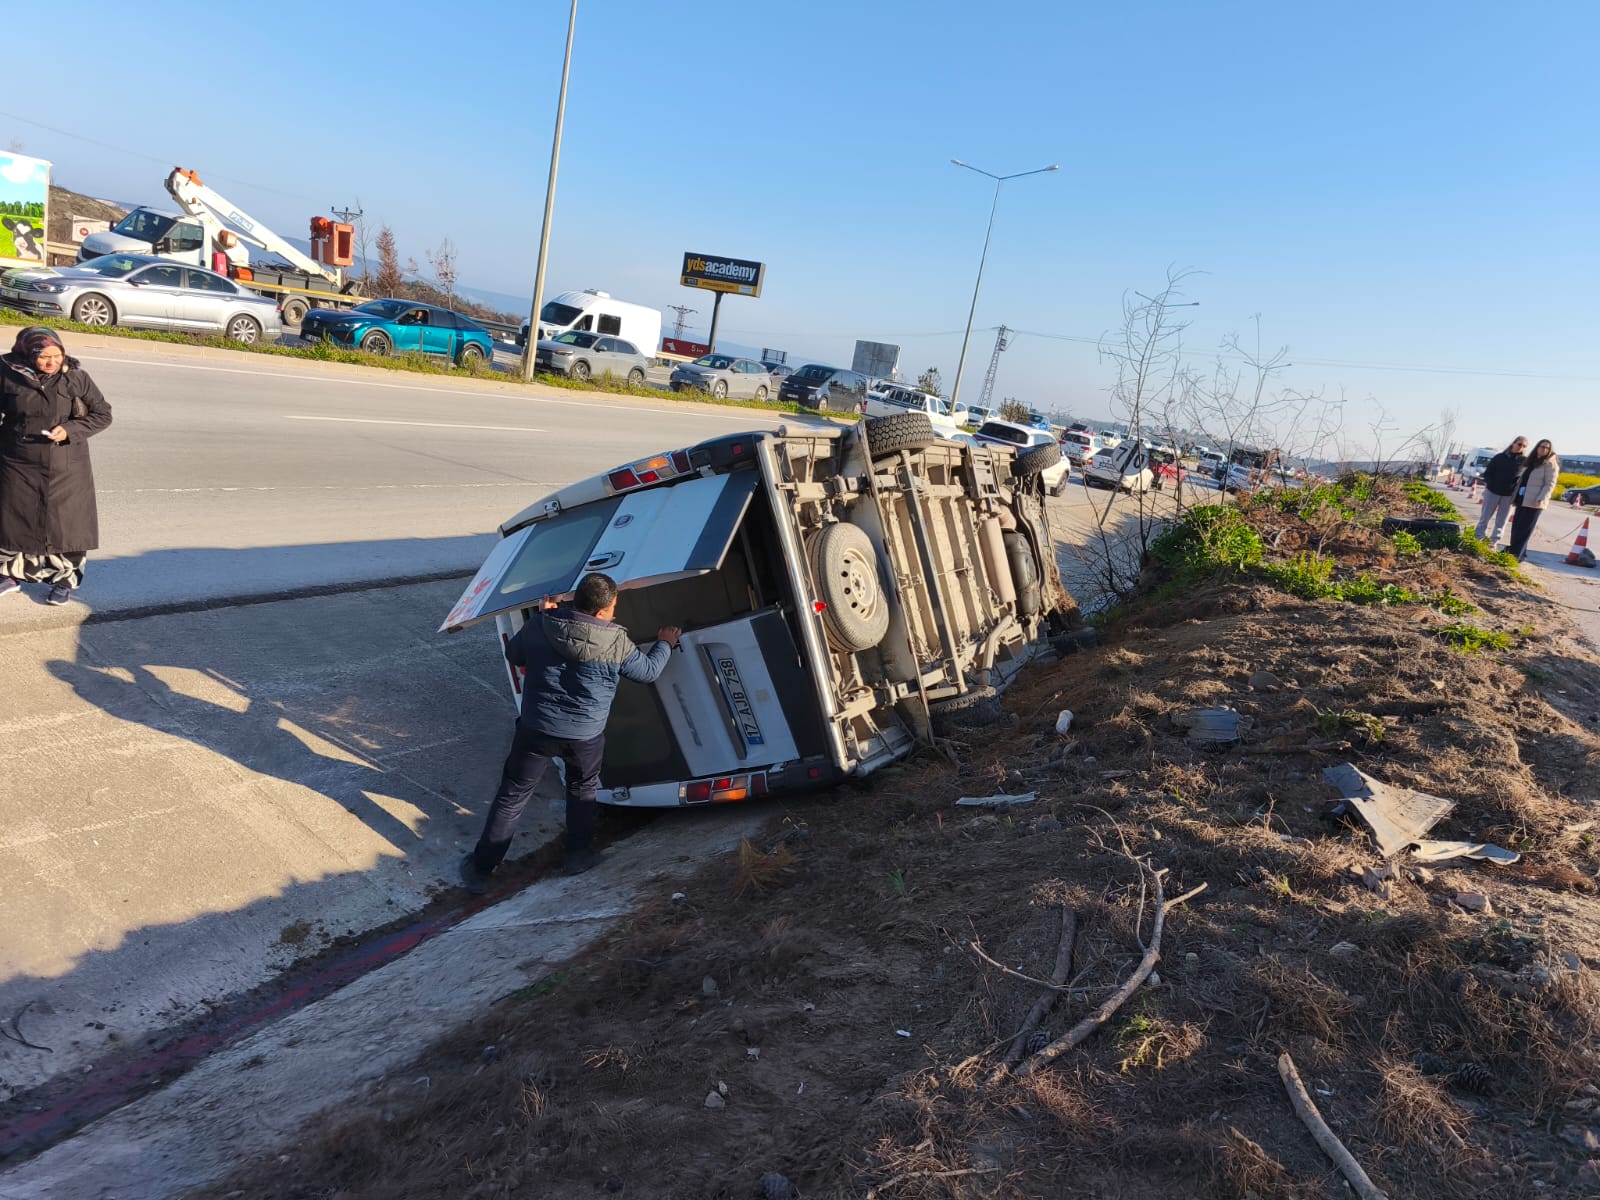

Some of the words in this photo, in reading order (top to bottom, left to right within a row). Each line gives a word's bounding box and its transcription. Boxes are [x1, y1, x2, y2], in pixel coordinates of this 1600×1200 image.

[686, 257, 757, 281] ydsacademy
[720, 660, 739, 684] 758
[733, 692, 751, 715] AJB
[744, 723, 758, 736] 17
